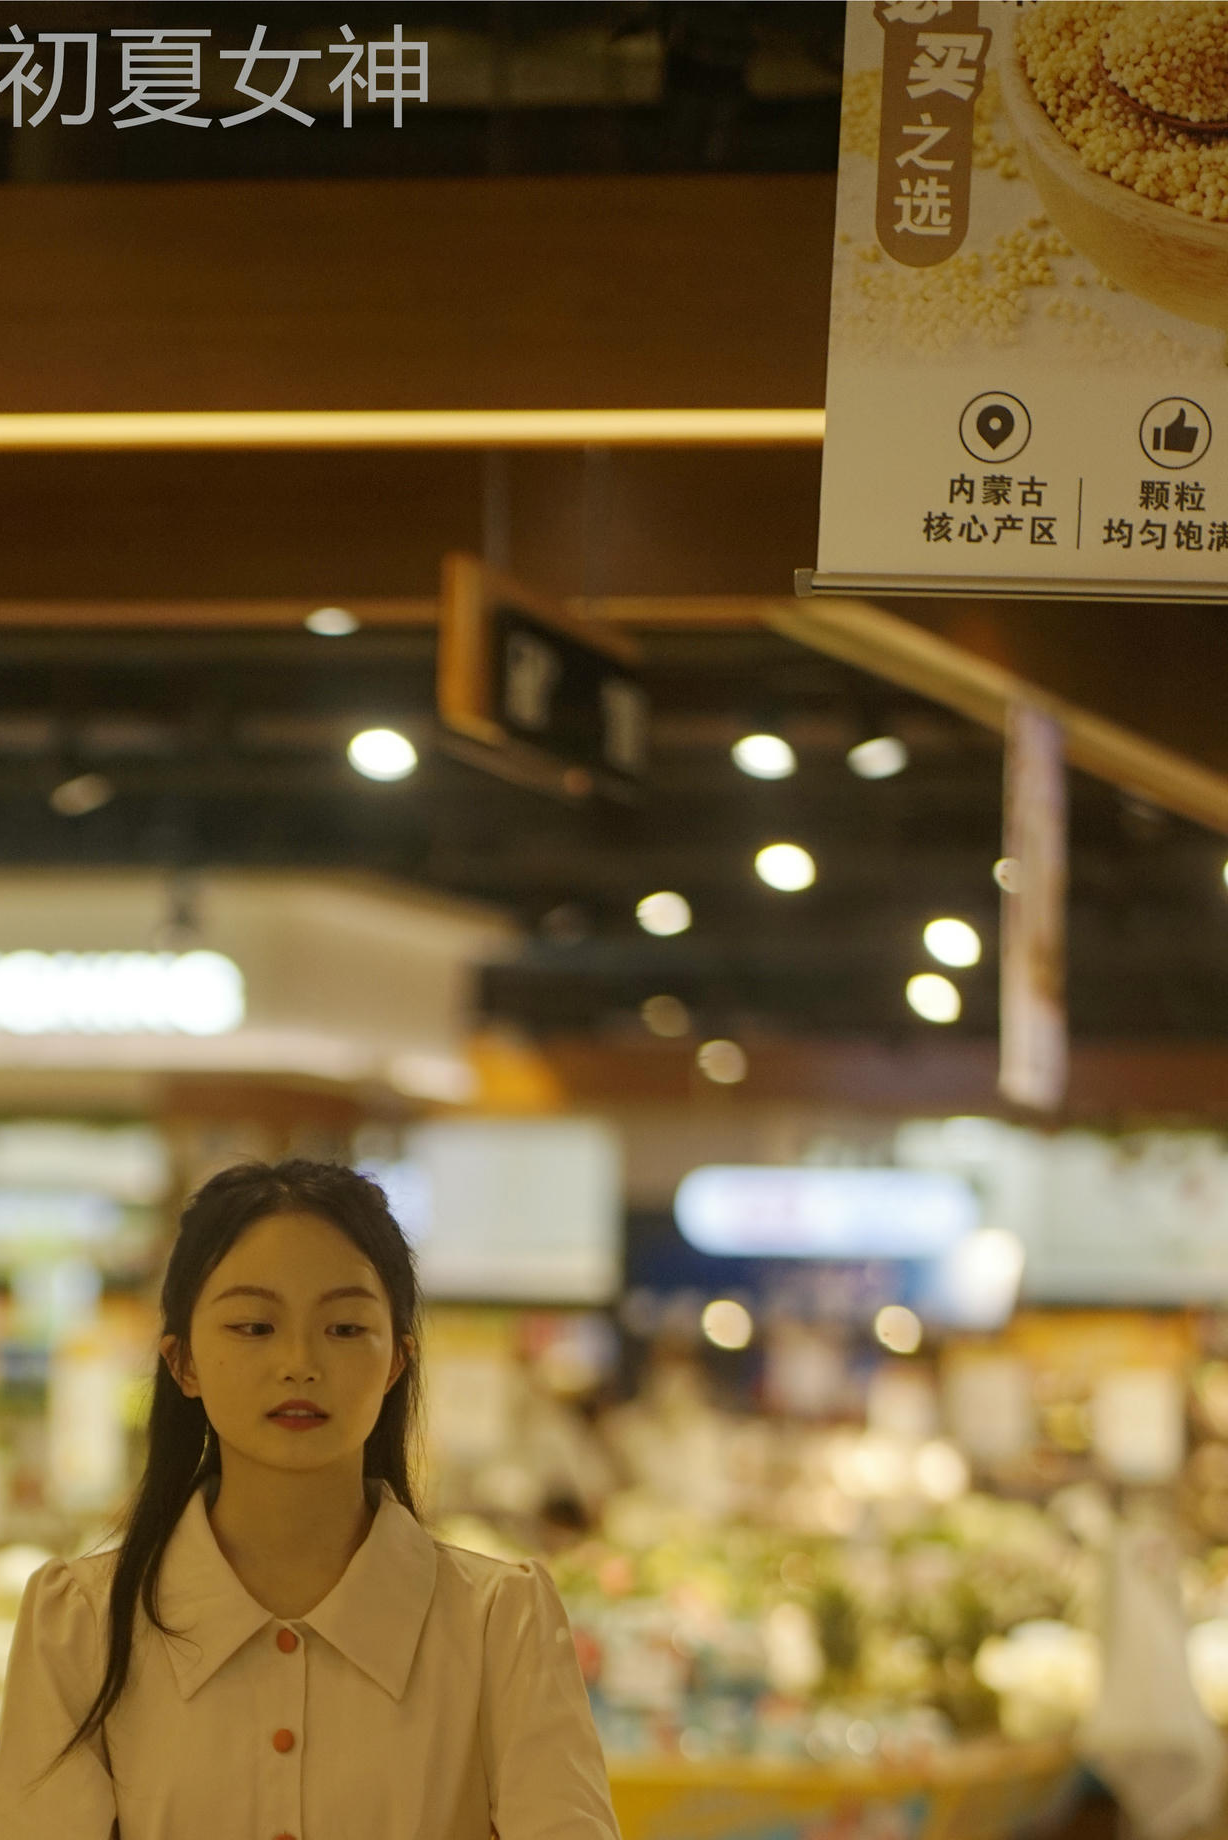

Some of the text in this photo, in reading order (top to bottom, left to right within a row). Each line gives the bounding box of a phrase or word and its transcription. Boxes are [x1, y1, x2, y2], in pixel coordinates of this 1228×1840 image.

[949, 473, 1048, 507] 内蒙古
[1139, 480, 1207, 513] 颗粒
[922, 511, 1058, 546] 核心产区
